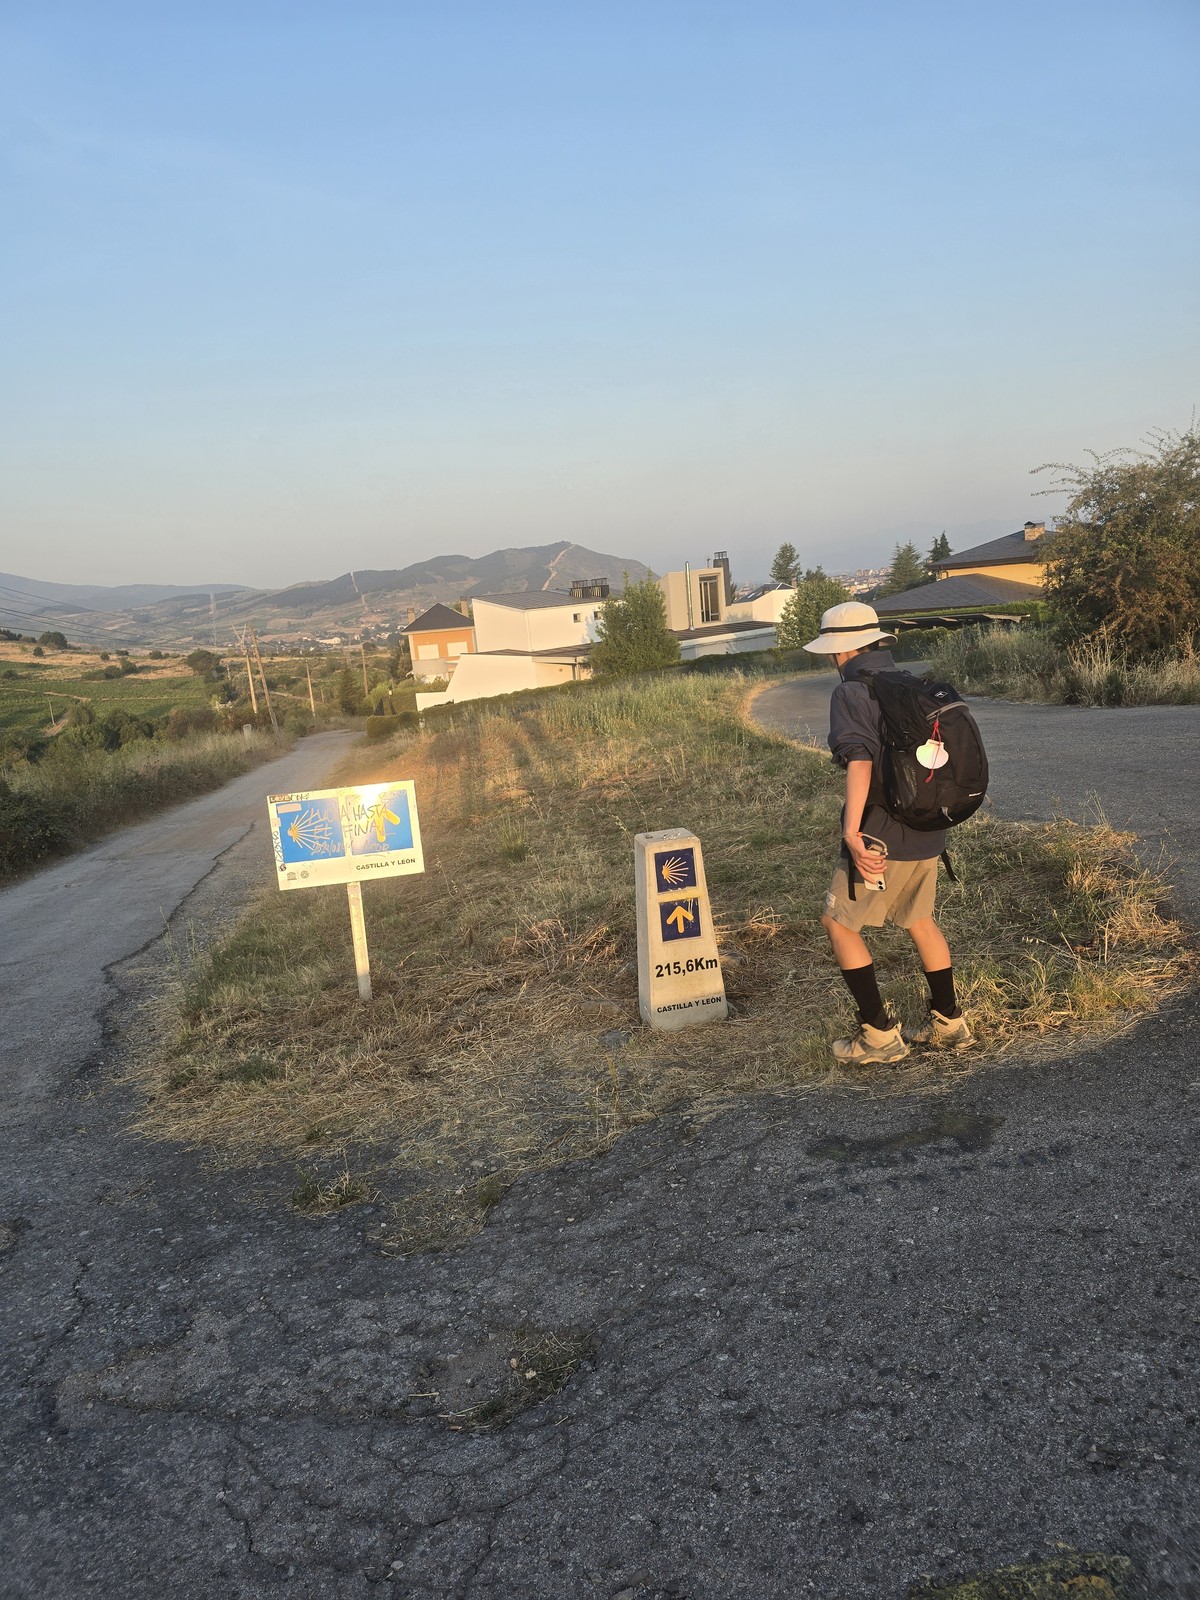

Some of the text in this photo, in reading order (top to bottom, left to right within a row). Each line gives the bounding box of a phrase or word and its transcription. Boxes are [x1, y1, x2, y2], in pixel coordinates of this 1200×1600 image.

[356, 861, 389, 871] CASTILLA
[655, 956, 718, 978] 215,6Km
[657, 1001, 693, 1013] CASTILLA
